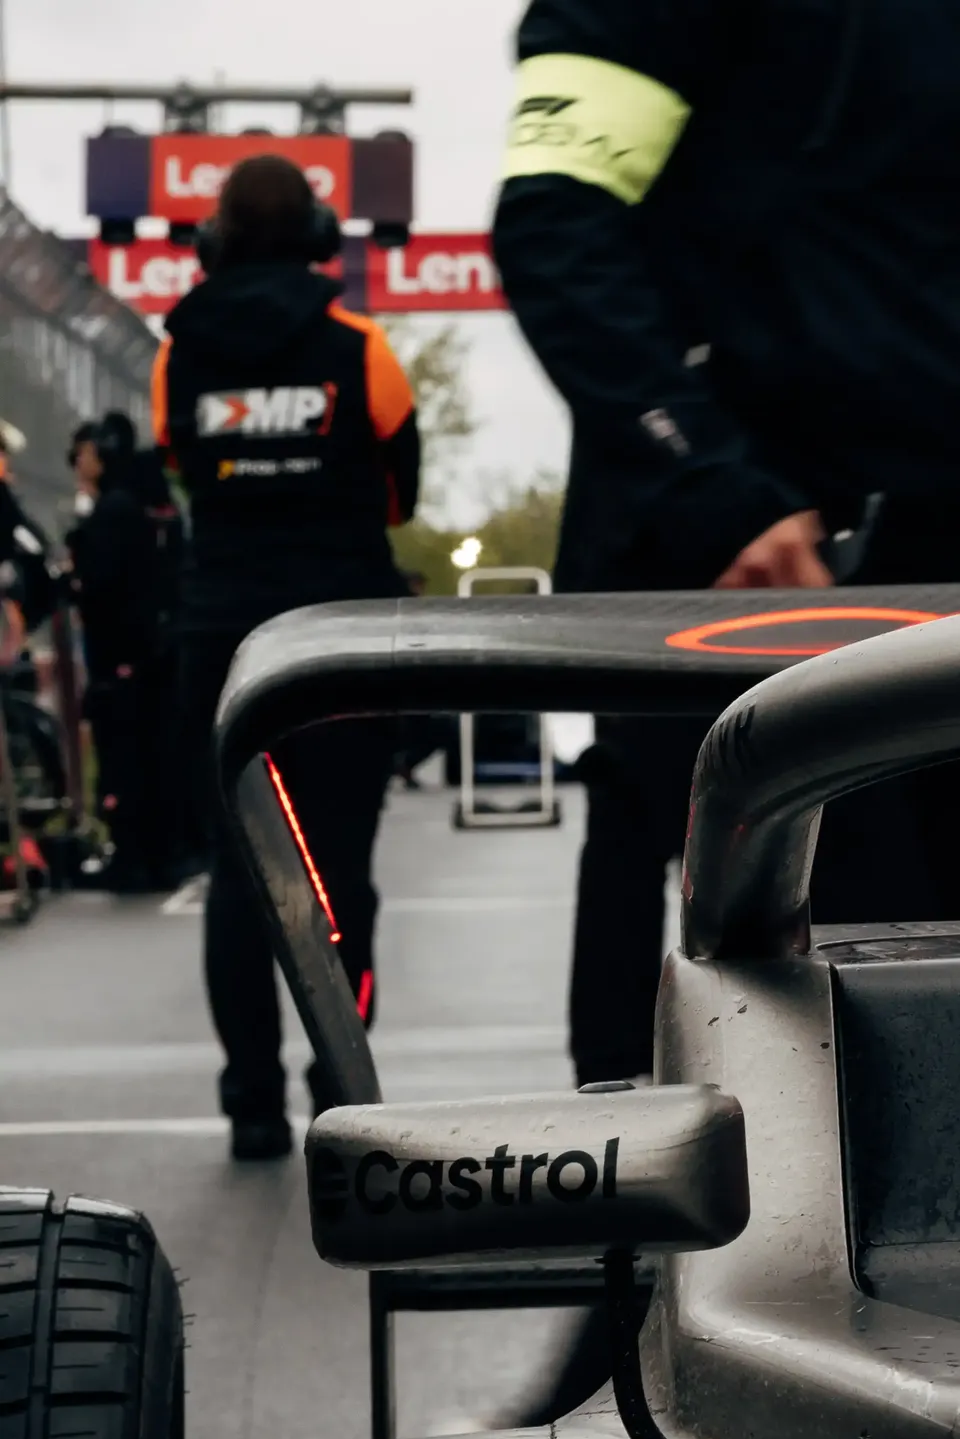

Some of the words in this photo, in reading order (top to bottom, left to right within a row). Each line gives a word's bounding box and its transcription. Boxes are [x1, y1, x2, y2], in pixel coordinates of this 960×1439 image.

[165, 155, 336, 199] Leo
[386, 246, 500, 295] Len
[354, 1136, 620, 1215] Castrol
